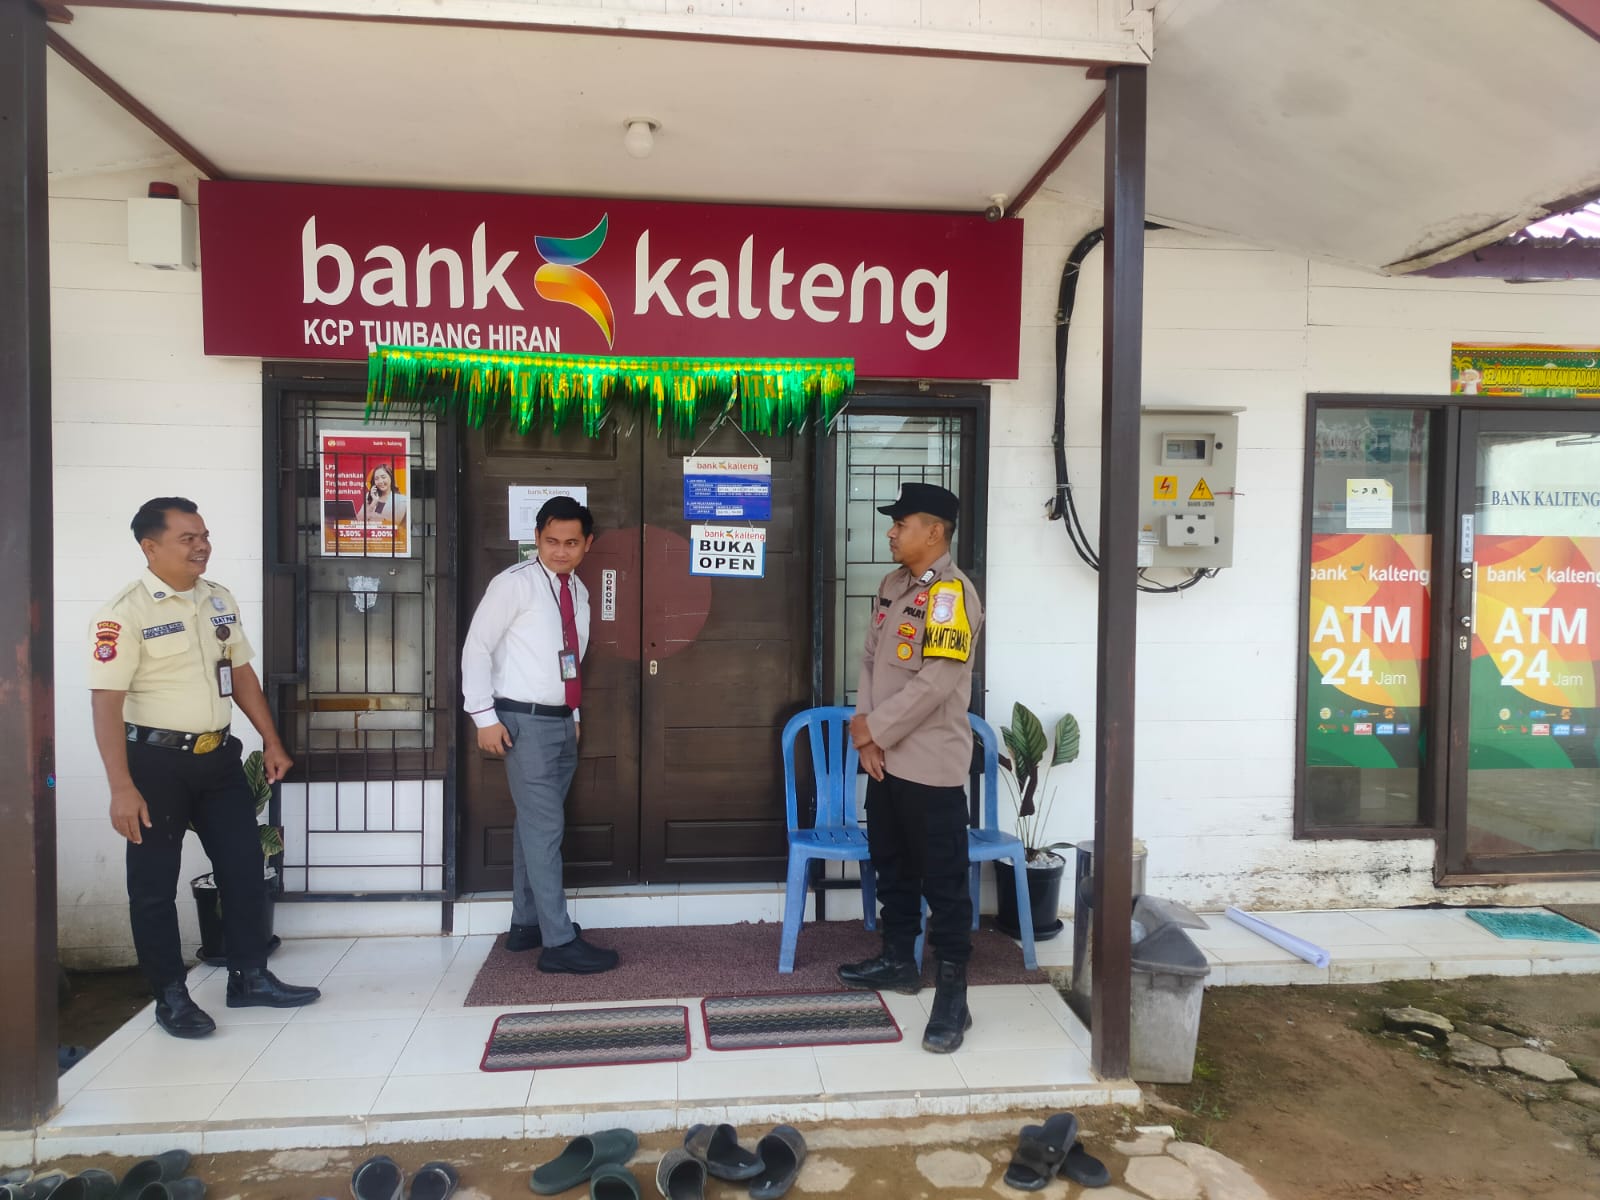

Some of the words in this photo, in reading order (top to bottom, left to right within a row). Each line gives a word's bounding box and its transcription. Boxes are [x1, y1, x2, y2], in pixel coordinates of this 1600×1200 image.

[302, 215, 525, 311] bank
[634, 228, 949, 352] kalteng
[303, 318, 354, 346] KCP
[360, 320, 481, 349] TUMBANG
[488, 324, 561, 353] HIRAN
[697, 461, 717, 469] bank
[728, 461, 758, 471] kalteng
[1491, 490, 1531, 506] BANK
[1534, 492, 1600, 507] KALTENG
[700, 540, 755, 553] BUKA
[735, 532, 764, 541] kalteng
[700, 558, 755, 570] OPEN
[1487, 566, 1526, 582] bank
[1369, 565, 1430, 585] kalteng
[1313, 606, 1411, 643] ATM
[1494, 607, 1588, 644] ATM
[1320, 648, 1373, 684] 24
[1376, 672, 1406, 685] Jam
[1500, 648, 1550, 686] 24
[1553, 673, 1583, 686] Jam
